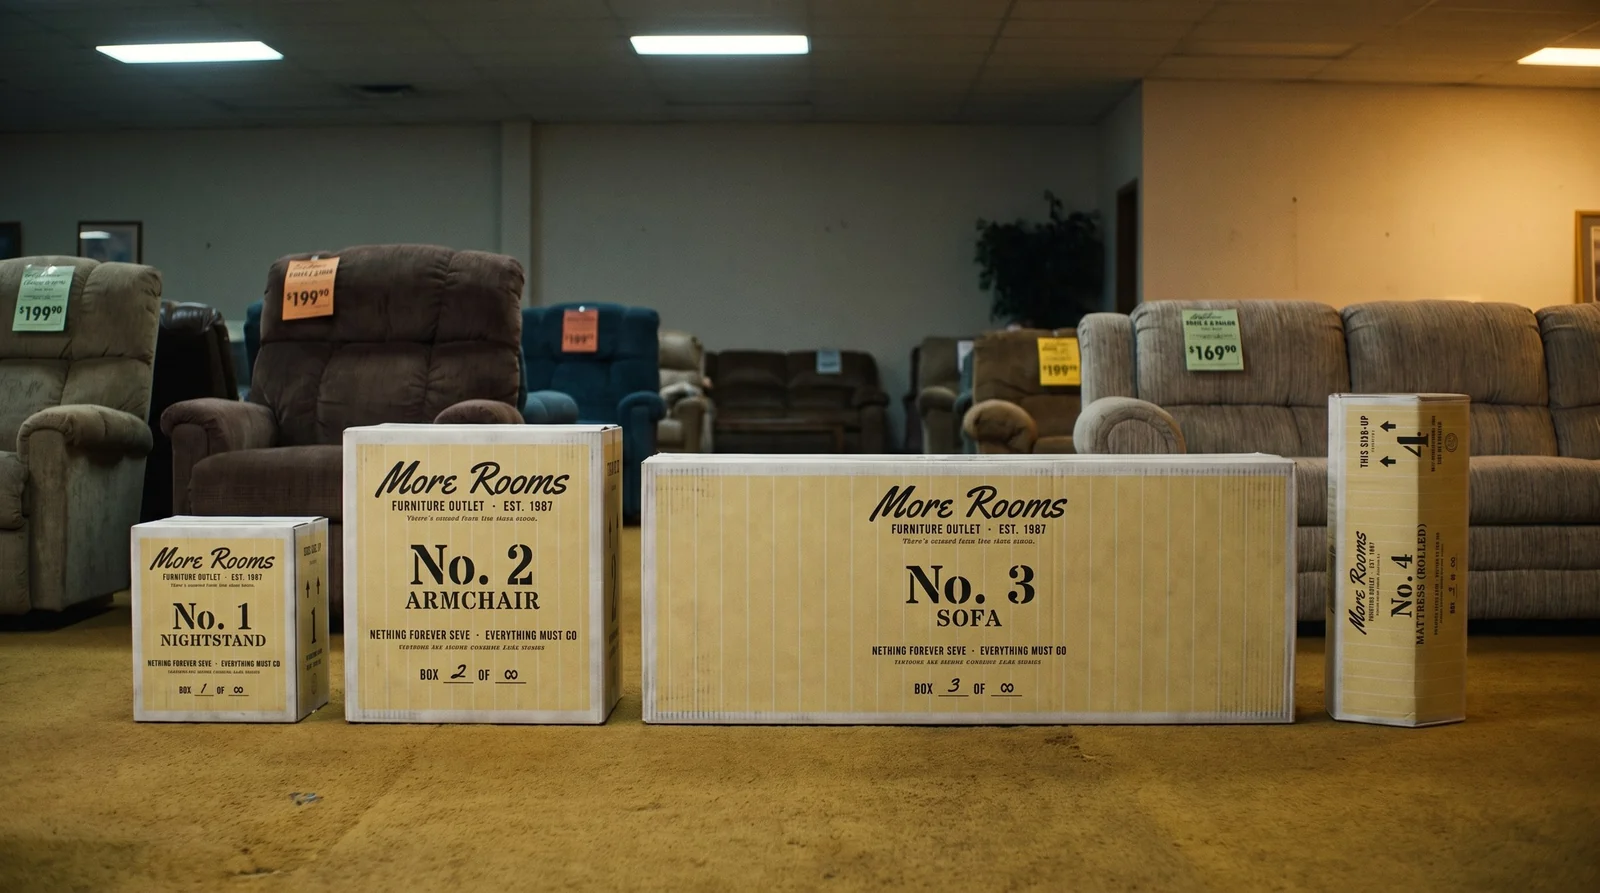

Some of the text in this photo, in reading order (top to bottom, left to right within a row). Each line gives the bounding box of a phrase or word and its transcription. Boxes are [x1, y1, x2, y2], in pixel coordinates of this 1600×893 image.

[1360, 450, 1369, 468] THIS
[375, 460, 457, 498] More
[470, 461, 570, 496] Rooms
[392, 501, 553, 512] FURNITURE OUTLET EST. 1987
[869, 485, 1068, 522] More Rooms
[891, 524, 1046, 535] FURNITURE OUTLET EST. 1987
[149, 547, 275, 570] More Rooms
[410, 544, 533, 585] No. 2
[162, 573, 262, 581] FURNITURE OUTLET EST. 1987
[905, 565, 1035, 604] No. 3
[1348, 531, 1367, 636] More Rooms
[1391, 554, 1413, 618] No. 4
[1416, 523, 1428, 645] MATTRESS (ROLLED)
[405, 591, 541, 610] ARMCHAIR
[172, 602, 252, 630] No. 1
[936, 609, 1003, 627] SOFA
[310, 607, 317, 644] 1
[160, 634, 267, 647] NIGHTSTAND
[370, 629, 407, 640] NETHING
[409, 629, 447, 640] FOREVER
[449, 629, 471, 640] SEVE
[485, 629, 537, 641] EVERYTHING
[540, 630, 563, 641] MUST
[872, 646, 907, 656] NETHING
[909, 646, 944, 656] FOREVER
[947, 646, 967, 656] SEVE
[980, 646, 1029, 656] EVERYTHING
[1031, 646, 1053, 656] MUST
[172, 660, 197, 668] FOREVER
[197, 660, 212, 668] SEVE
[221, 660, 255, 668] EVERYTHING
[256, 660, 271, 668] MUST
[420, 669, 439, 681] BOX
[450, 664, 467, 679] 2
[478, 669, 491, 681] OF
[179, 686, 192, 694] BOX
[216, 686, 225, 694] OF
[914, 683, 933, 694] BOX
[948, 678, 960, 693] 3
[974, 683, 985, 694] OF
